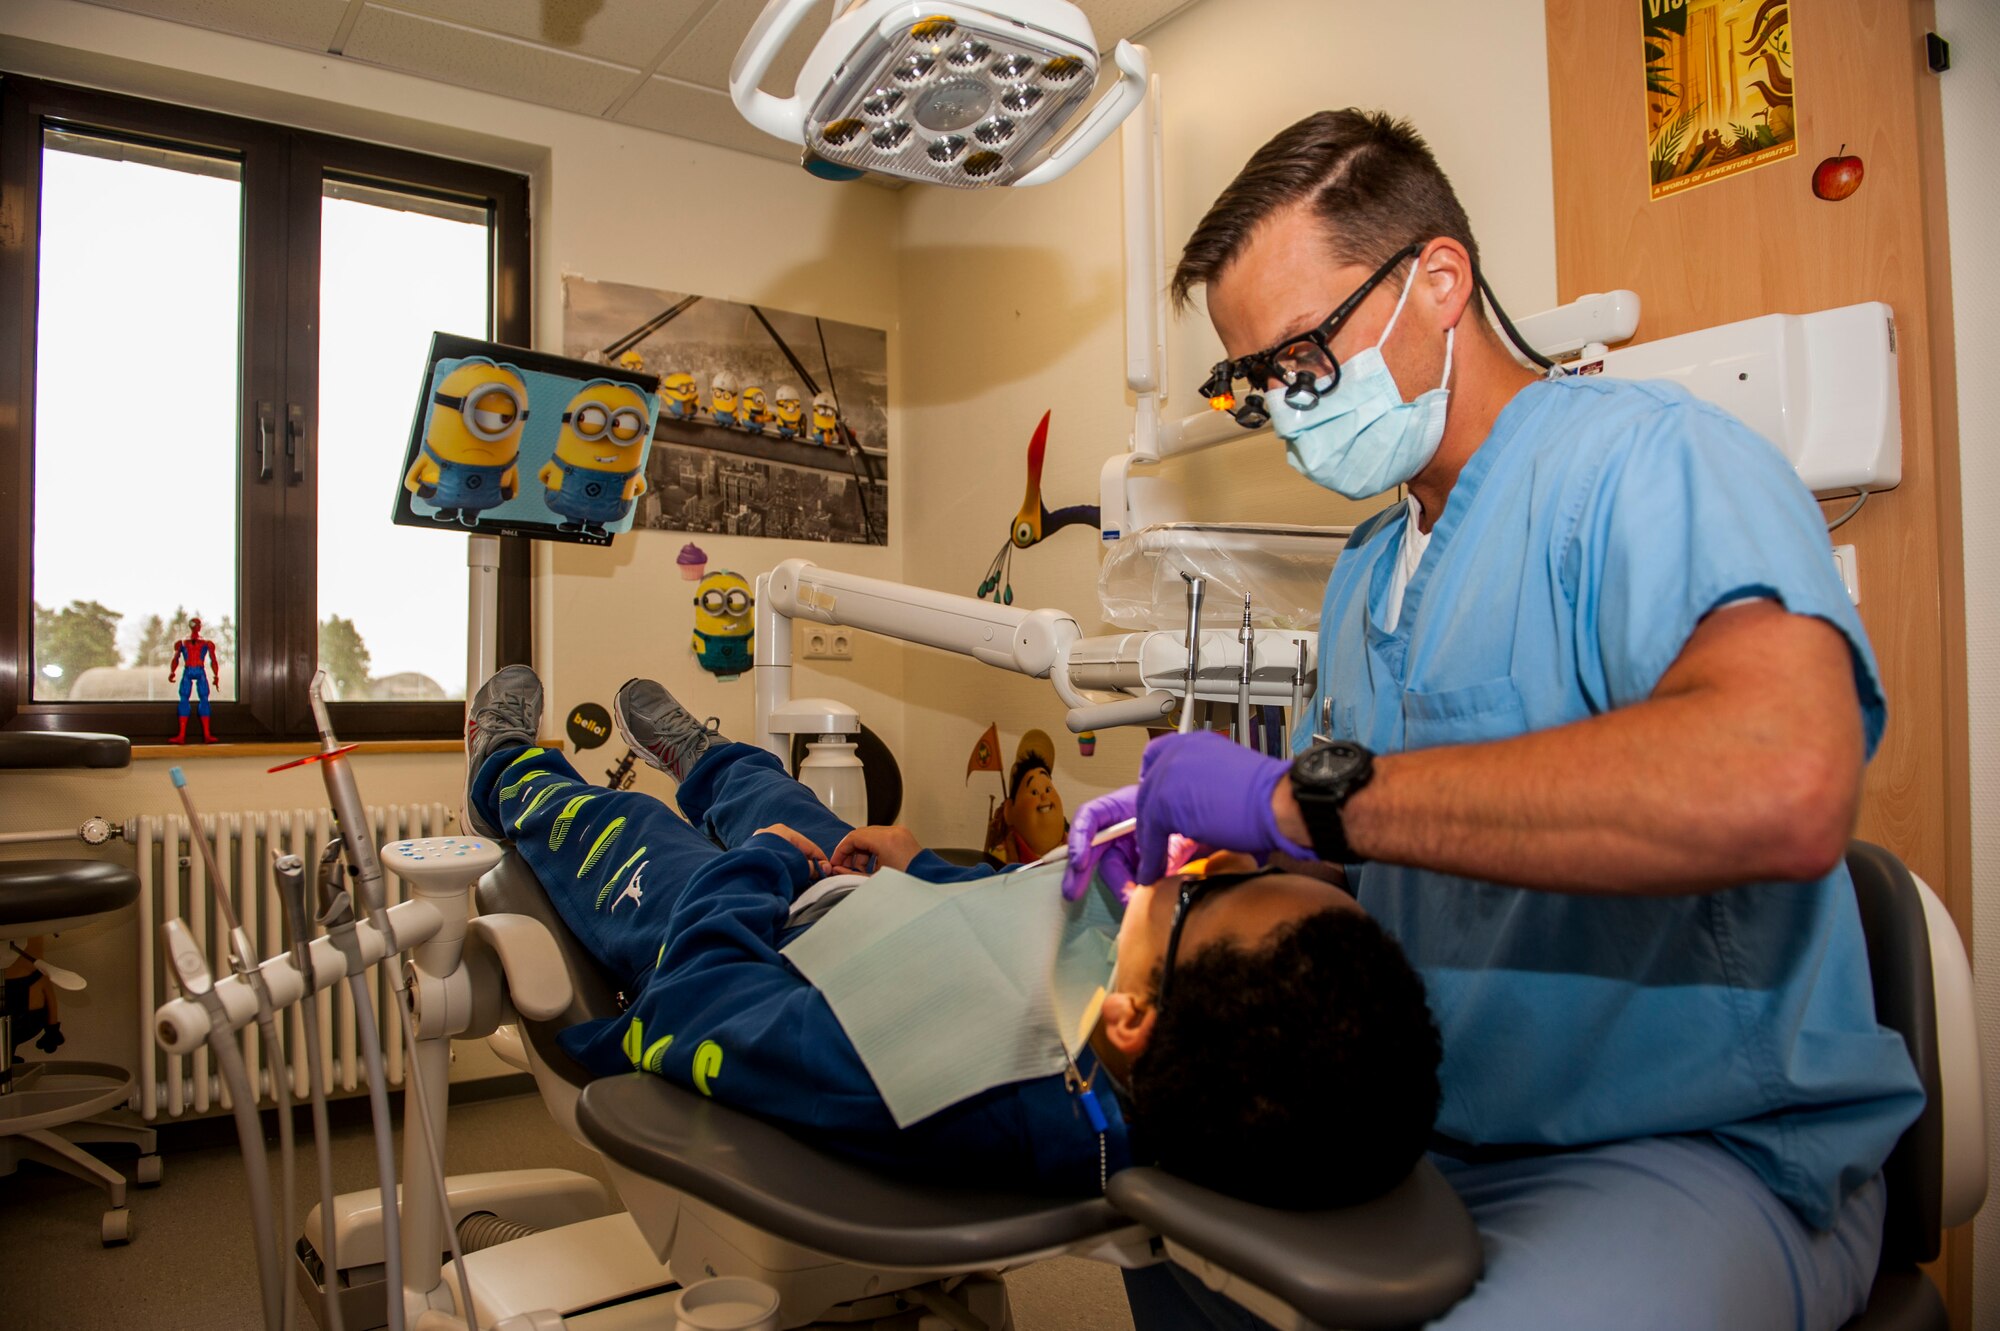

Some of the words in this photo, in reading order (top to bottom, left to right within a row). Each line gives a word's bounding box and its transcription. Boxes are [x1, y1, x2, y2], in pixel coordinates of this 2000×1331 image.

[1654, 186, 1661, 195] A
[1662, 178, 1690, 192] WORLD
[1691, 174, 1703, 182] OF
[1704, 156, 1755, 179] ADVENTURE
[1756, 144, 1794, 161] AWAITS!
[501, 529, 518, 537] DELL
[573, 712, 607, 737] bello!
